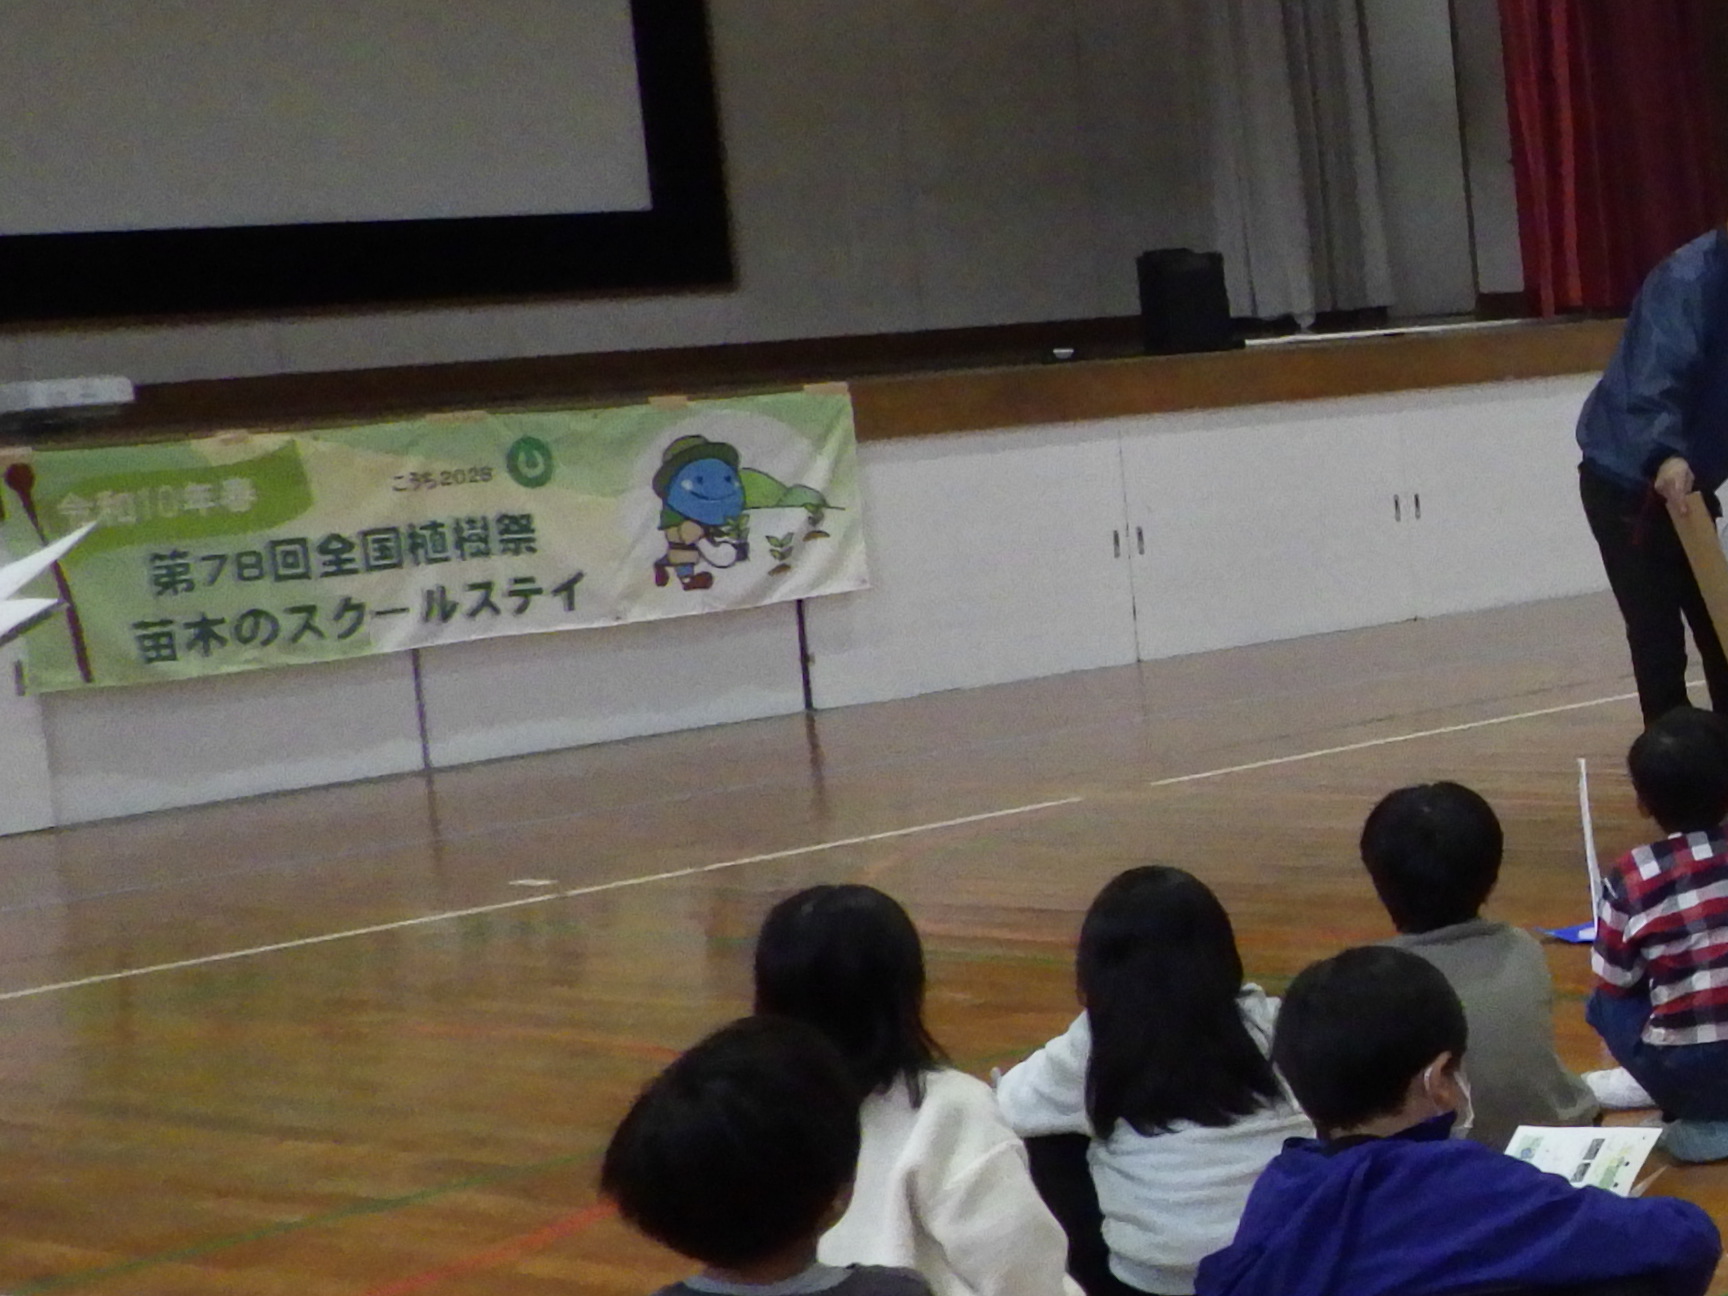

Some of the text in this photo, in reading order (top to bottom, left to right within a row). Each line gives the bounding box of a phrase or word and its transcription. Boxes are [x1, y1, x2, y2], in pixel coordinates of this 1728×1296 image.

[149, 512, 539, 598] 第78回全国植樹祭
[132, 569, 587, 666] 苗木のスクールステイ
